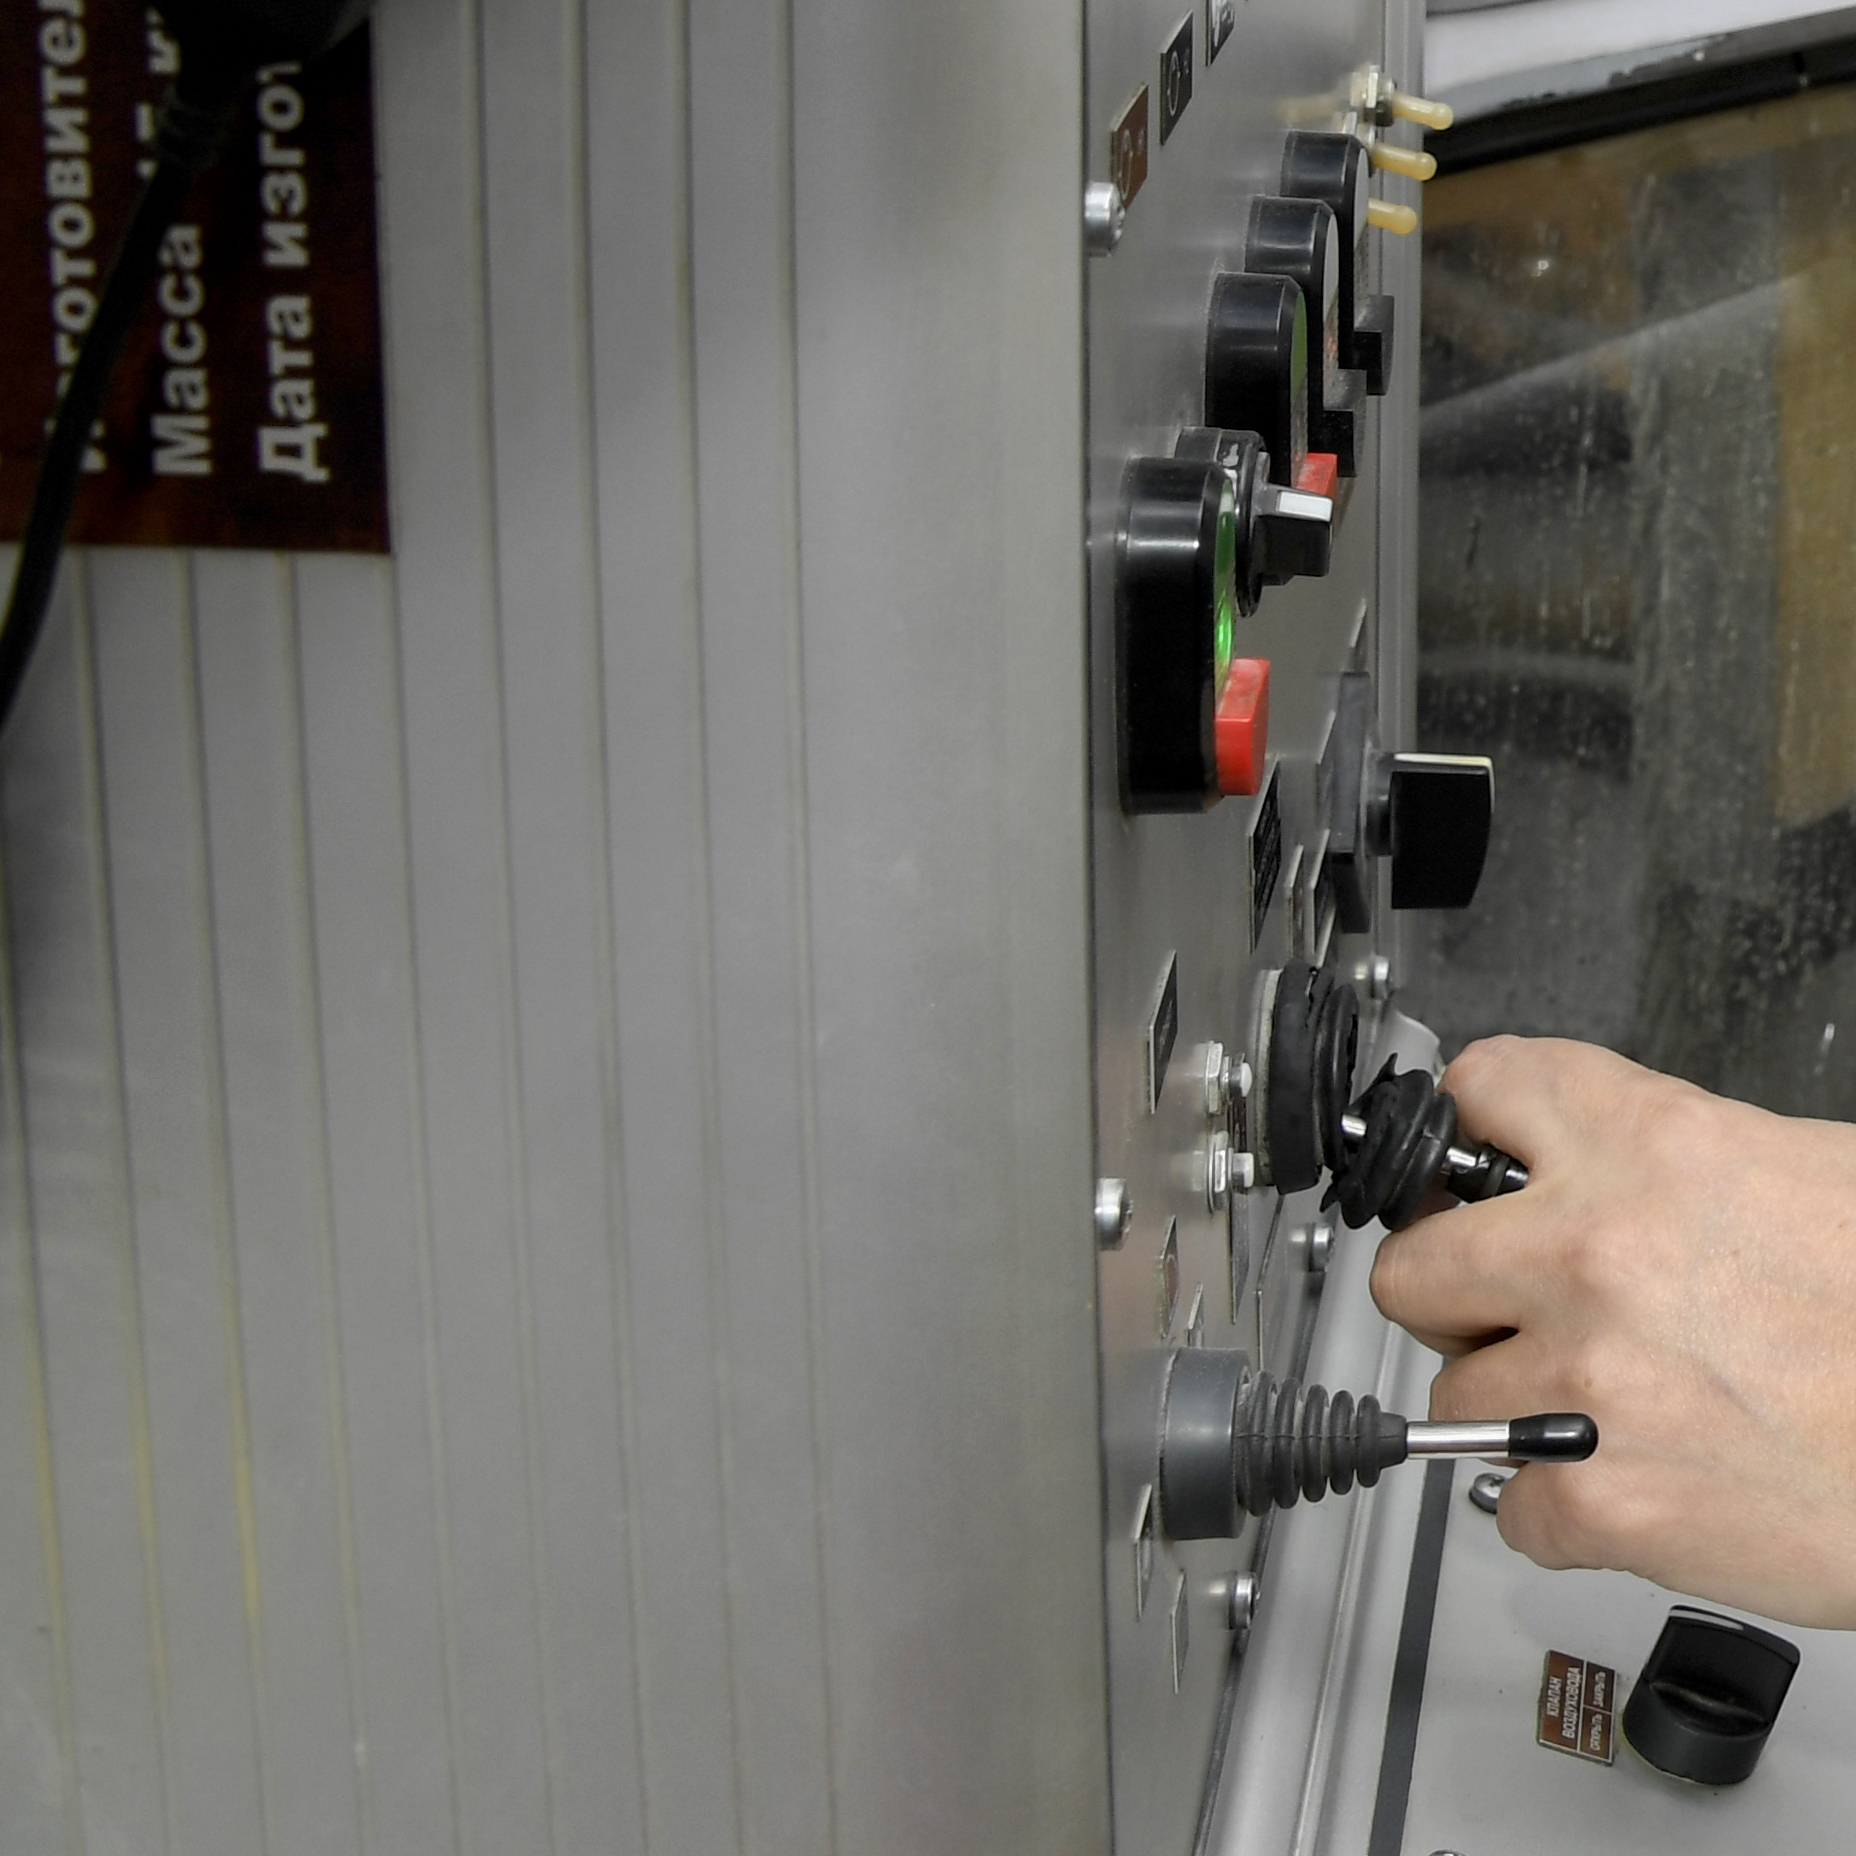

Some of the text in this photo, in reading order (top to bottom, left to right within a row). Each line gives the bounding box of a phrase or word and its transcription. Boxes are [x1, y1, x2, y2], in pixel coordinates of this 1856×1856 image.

[149, 223, 215, 477] Масса
[256, 295, 330, 483] Дата
[1545, 1675, 1562, 1718] КЛАПАН
[1561, 1666, 1583, 1739] ВОЗДУХОВОДА
[1589, 1670, 1607, 1752] ОТКРЫТЬ ЗАКРЫТЬ
